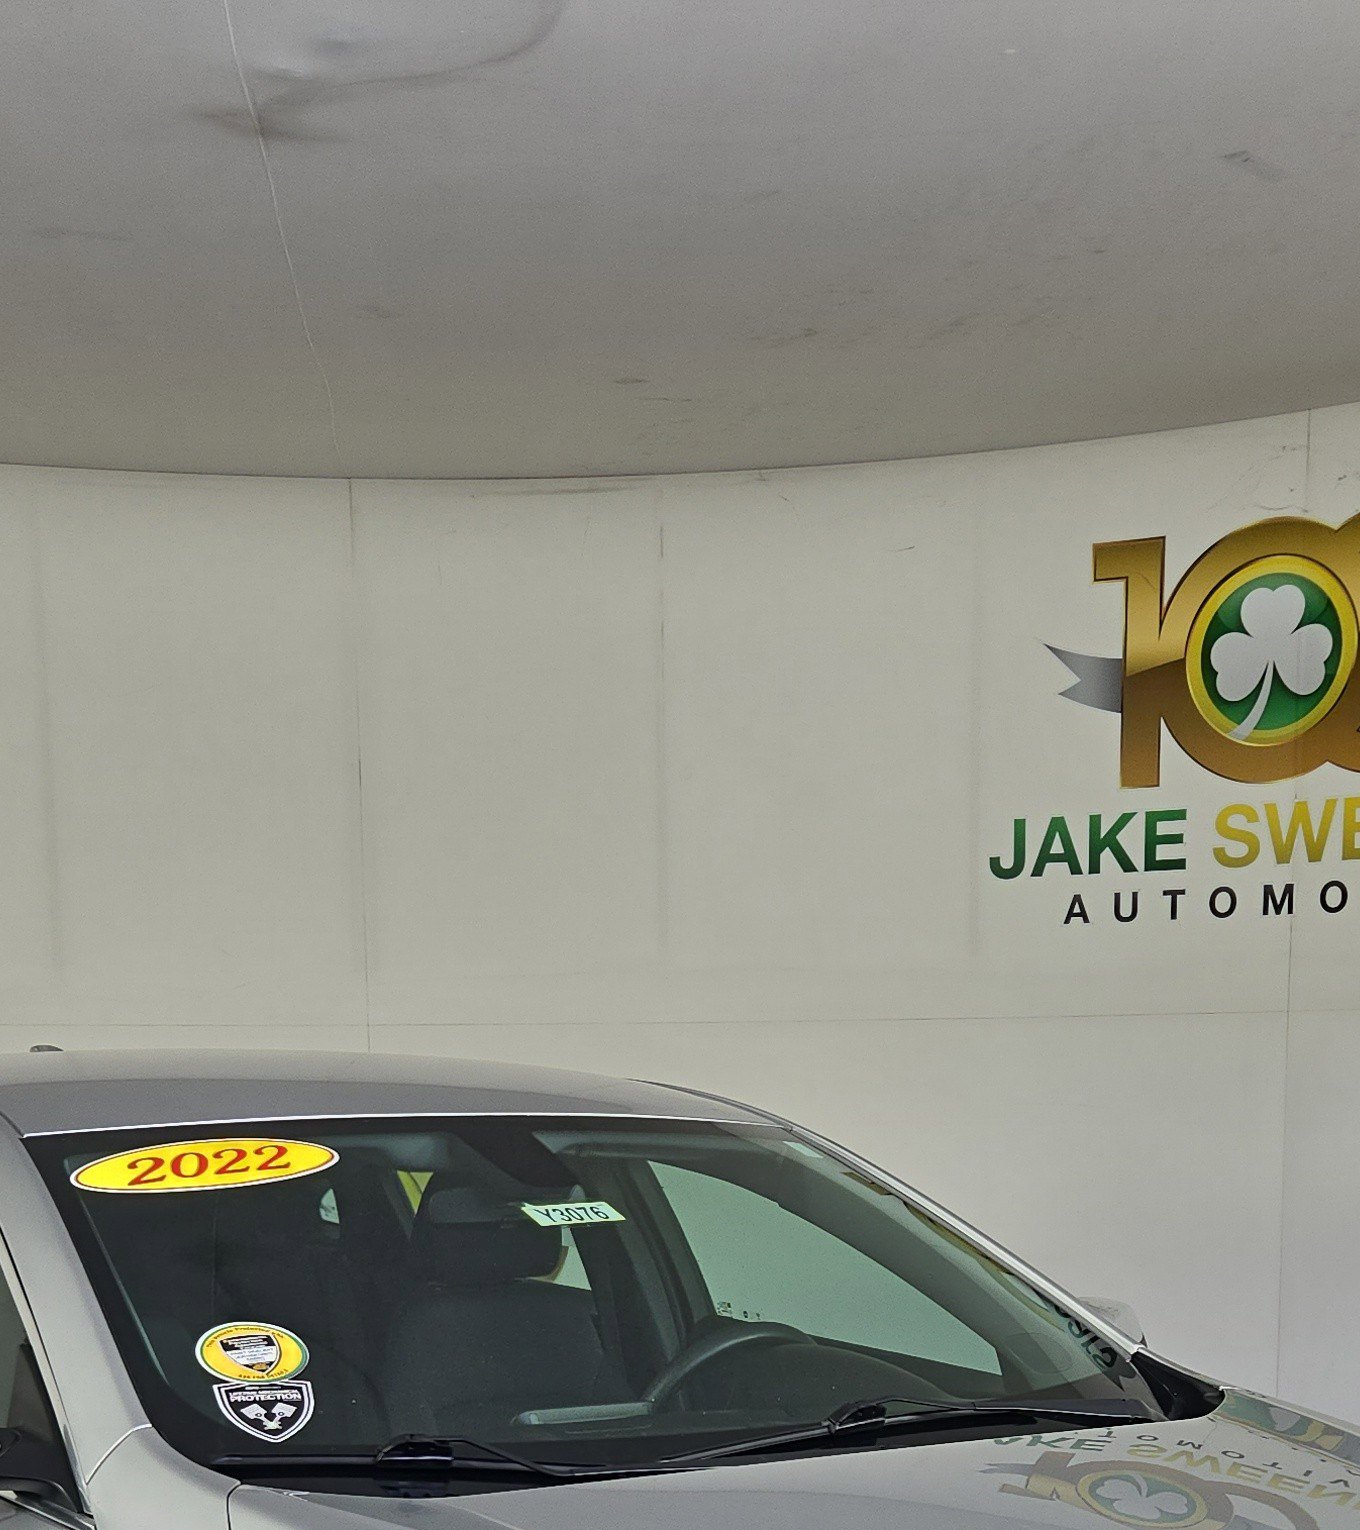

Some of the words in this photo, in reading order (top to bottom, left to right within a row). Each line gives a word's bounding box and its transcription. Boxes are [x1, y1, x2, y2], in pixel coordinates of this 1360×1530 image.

[989, 809, 1187, 880] JAKE
[126, 1144, 292, 1187] 2022
[533, 1206, 610, 1223] Y3076
[229, 1393, 302, 1402] PROTECTION
